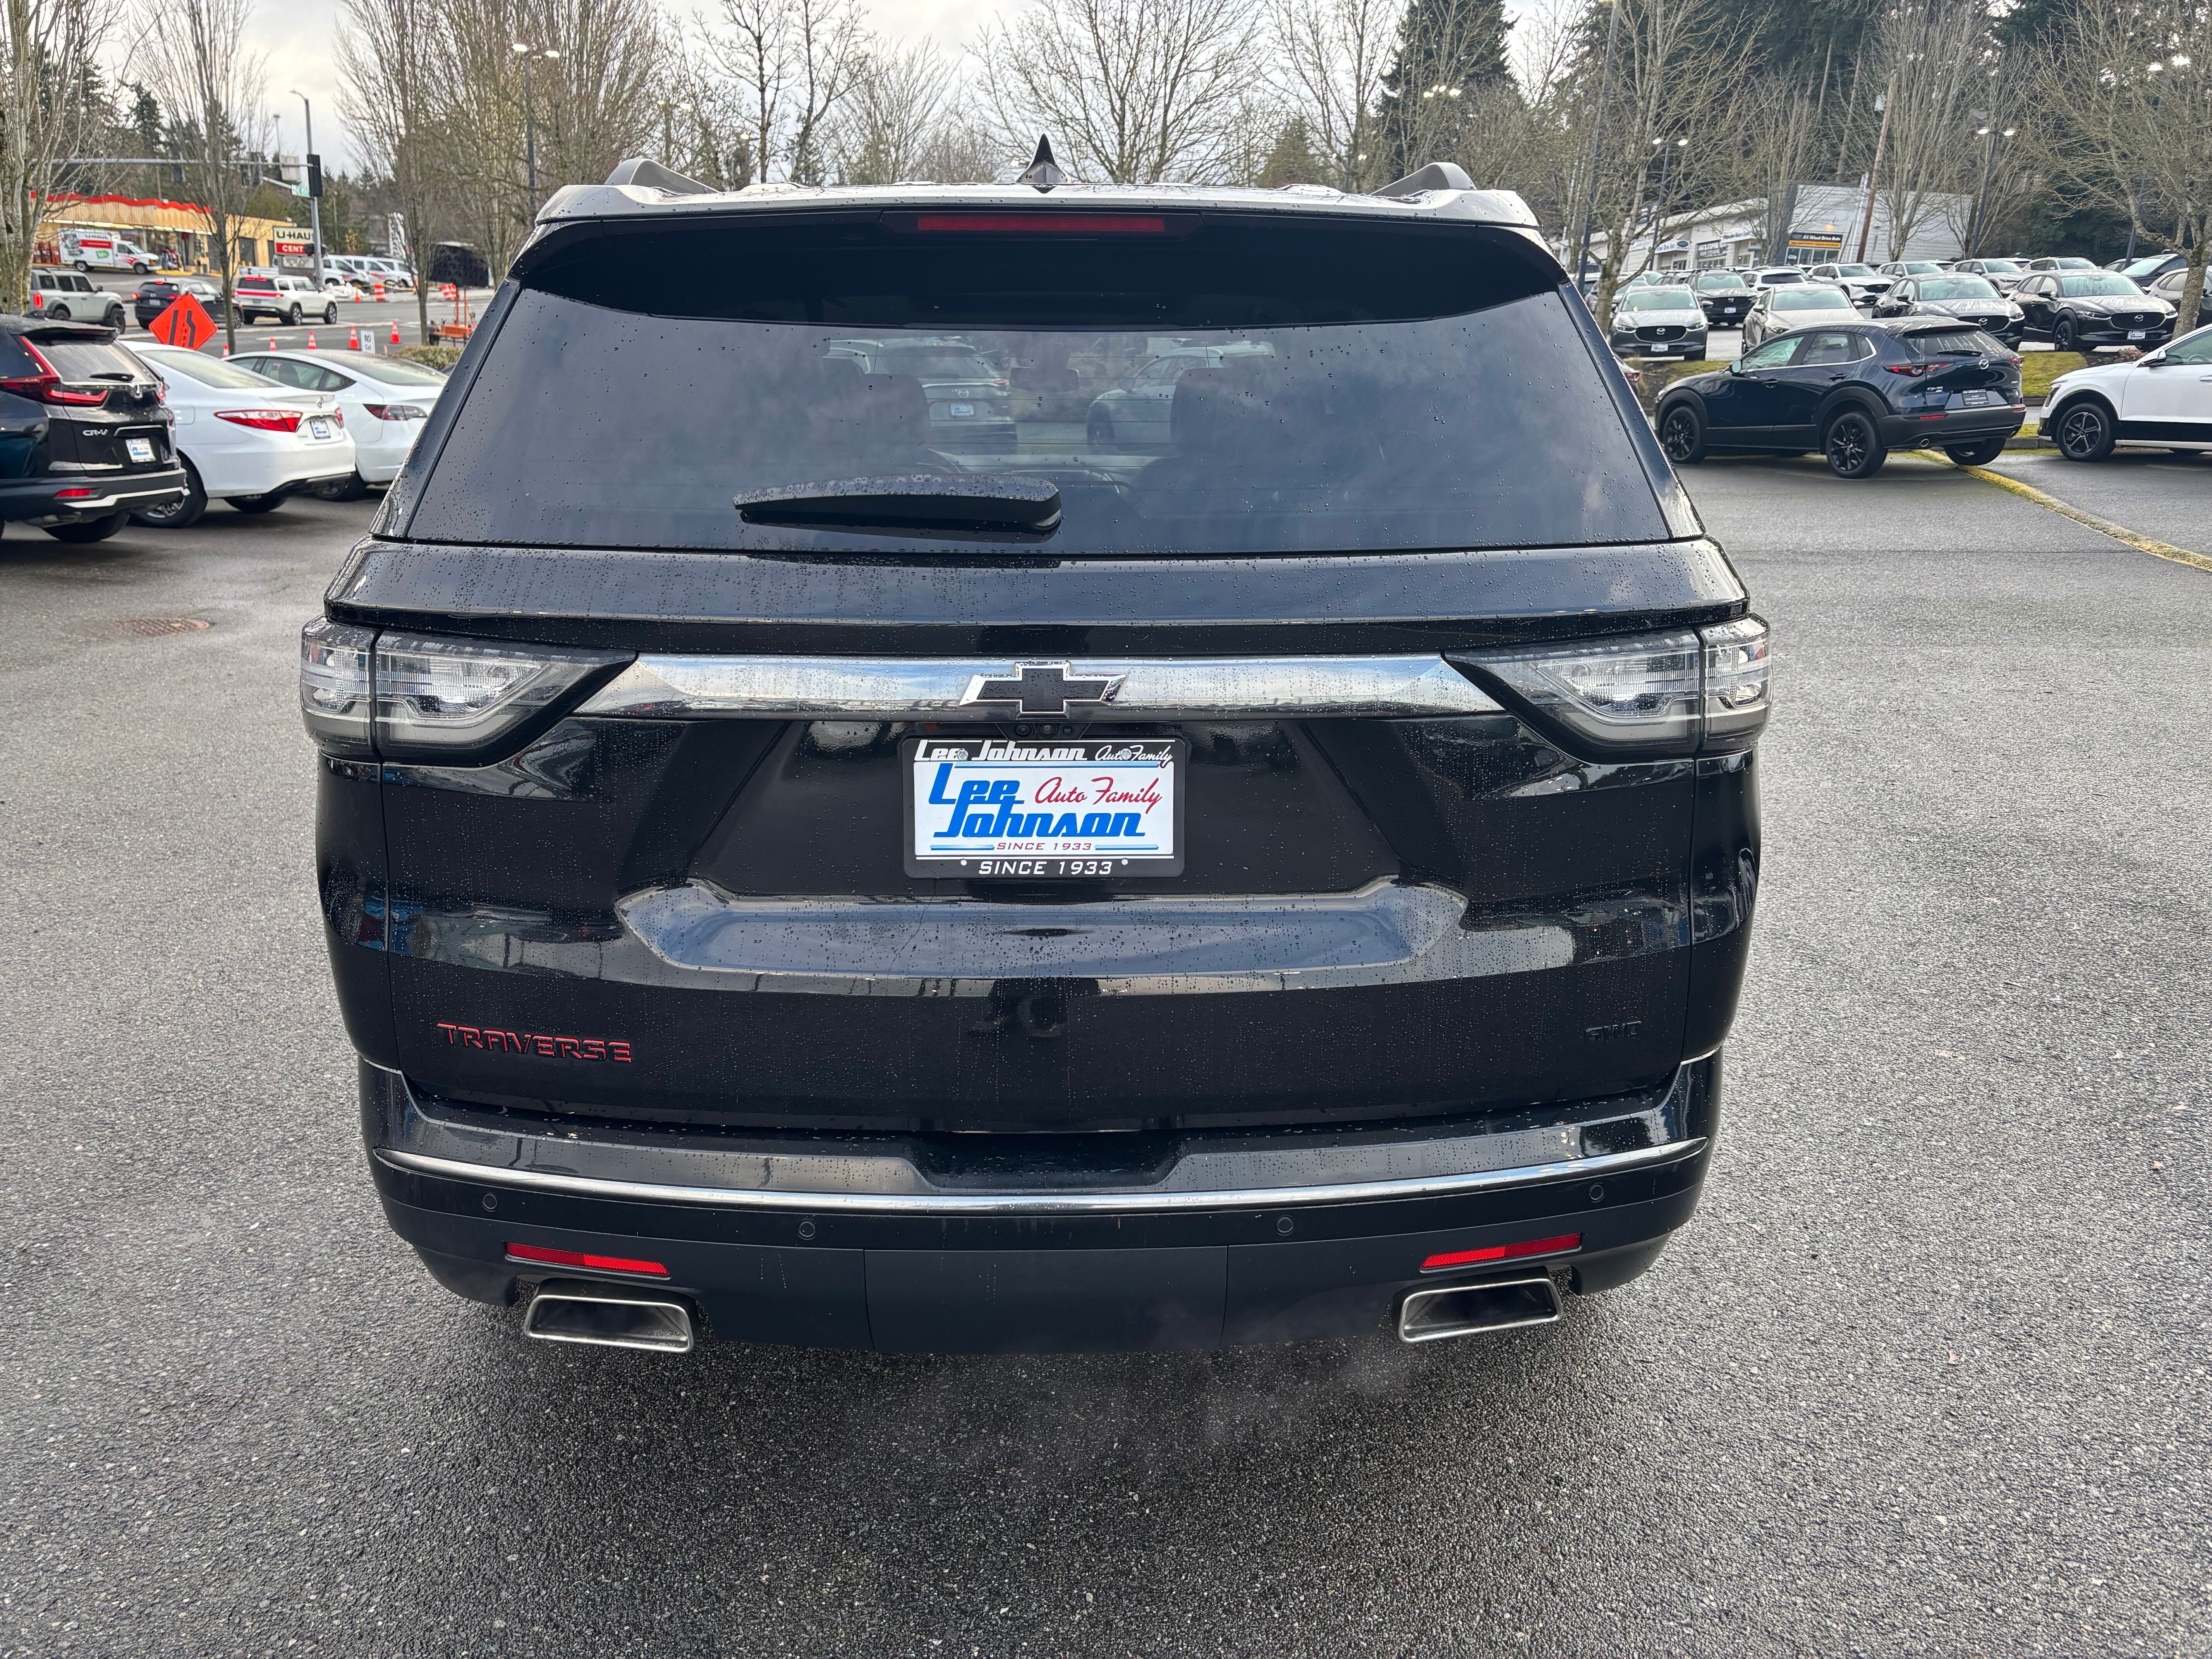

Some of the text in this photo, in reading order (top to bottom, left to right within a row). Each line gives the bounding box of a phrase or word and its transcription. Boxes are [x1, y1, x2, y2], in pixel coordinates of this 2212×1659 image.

[276, 230, 313, 240] U-HAU
[282, 244, 309, 253] CENT
[971, 740, 1087, 761] Johnson
[1095, 745, 1130, 761] Aut
[1128, 745, 1173, 768] Family
[928, 763, 1024, 804] Lee
[1035, 776, 1162, 814] Auto Family
[933, 799, 1146, 838] Johnson
[996, 842, 1046, 850] SINCE
[979, 861, 1113, 875] SINCE 1933
[436, 1022, 632, 1063] TRAVERSE
